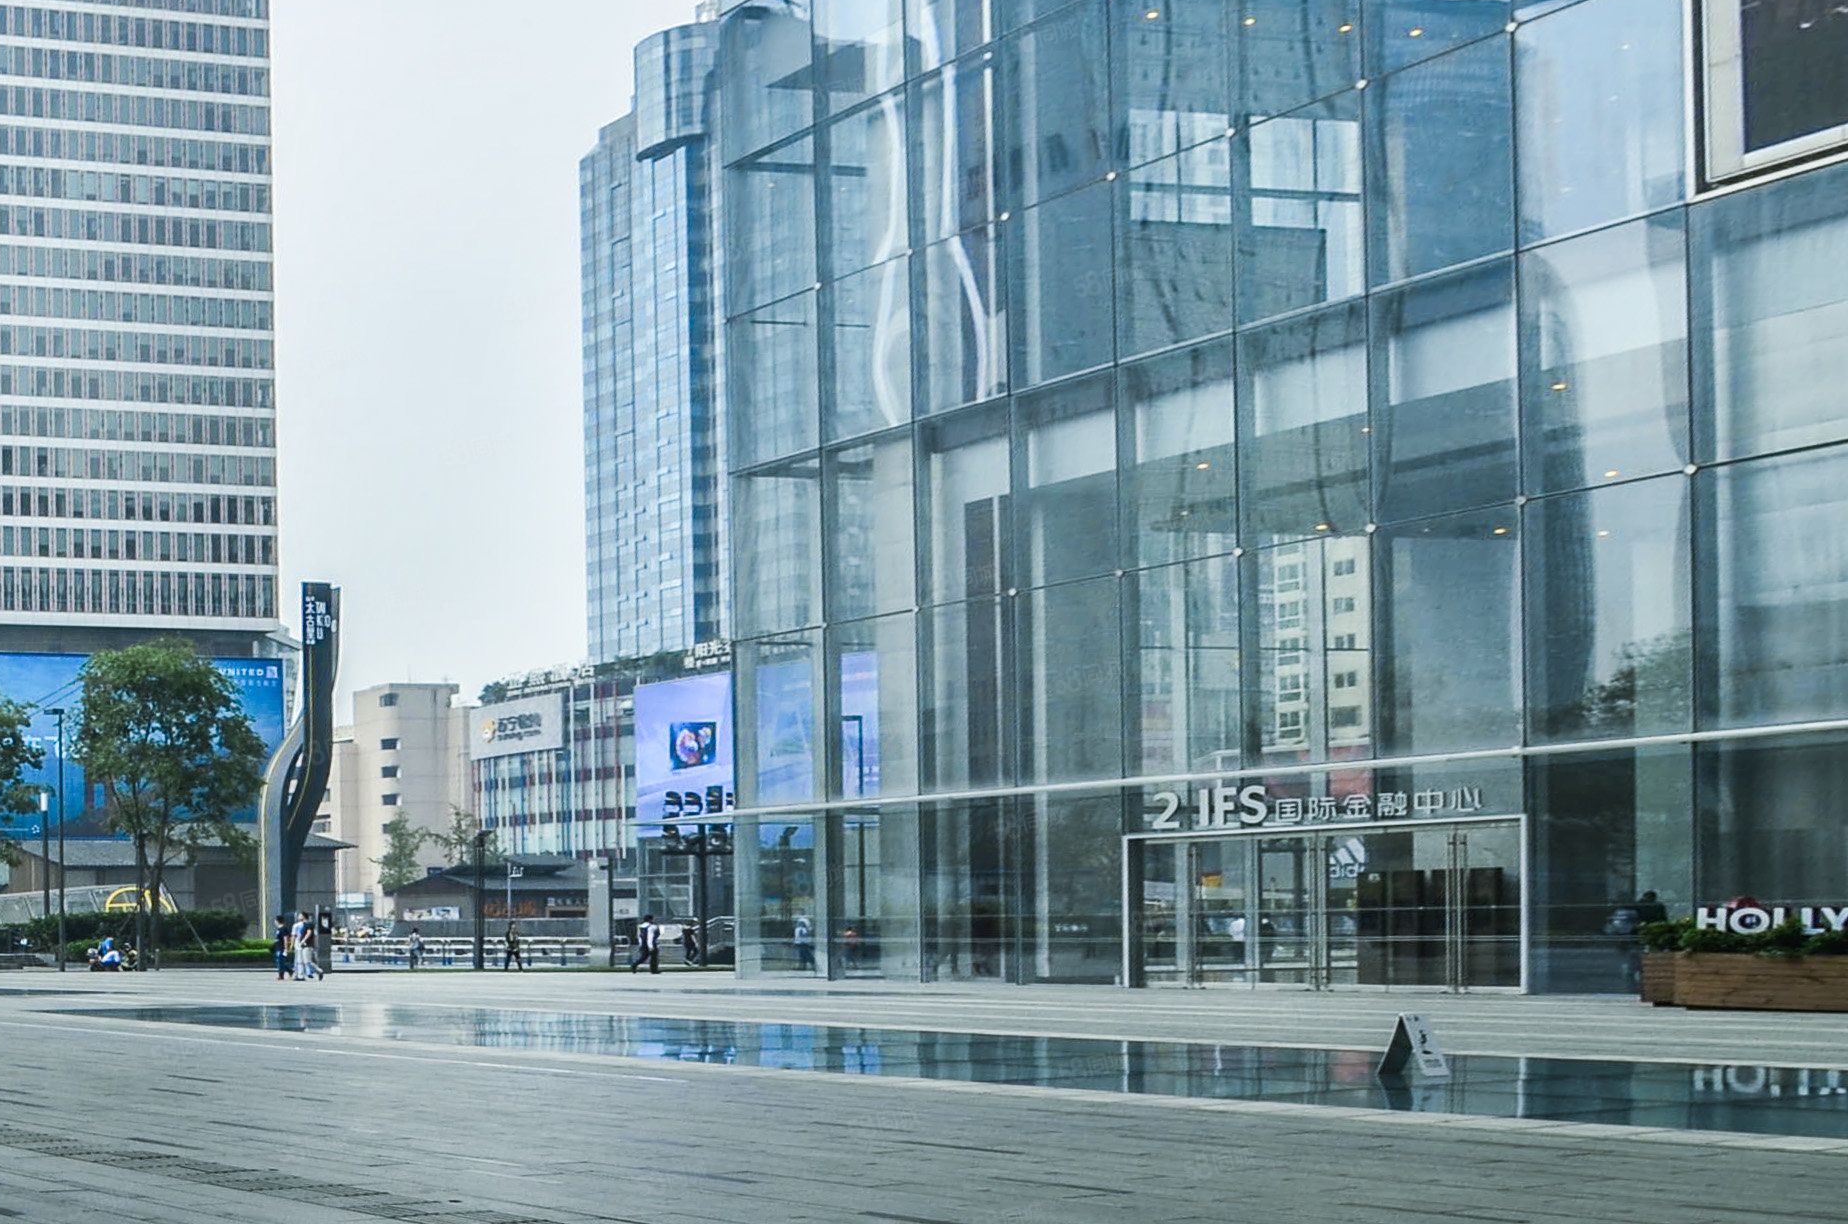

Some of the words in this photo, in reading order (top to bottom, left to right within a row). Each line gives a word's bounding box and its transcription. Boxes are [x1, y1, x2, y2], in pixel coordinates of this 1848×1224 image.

[1152, 791, 1181, 830] 2
[1198, 785, 1269, 827] IFS
[1275, 786, 1483, 823] 国际金融中心
